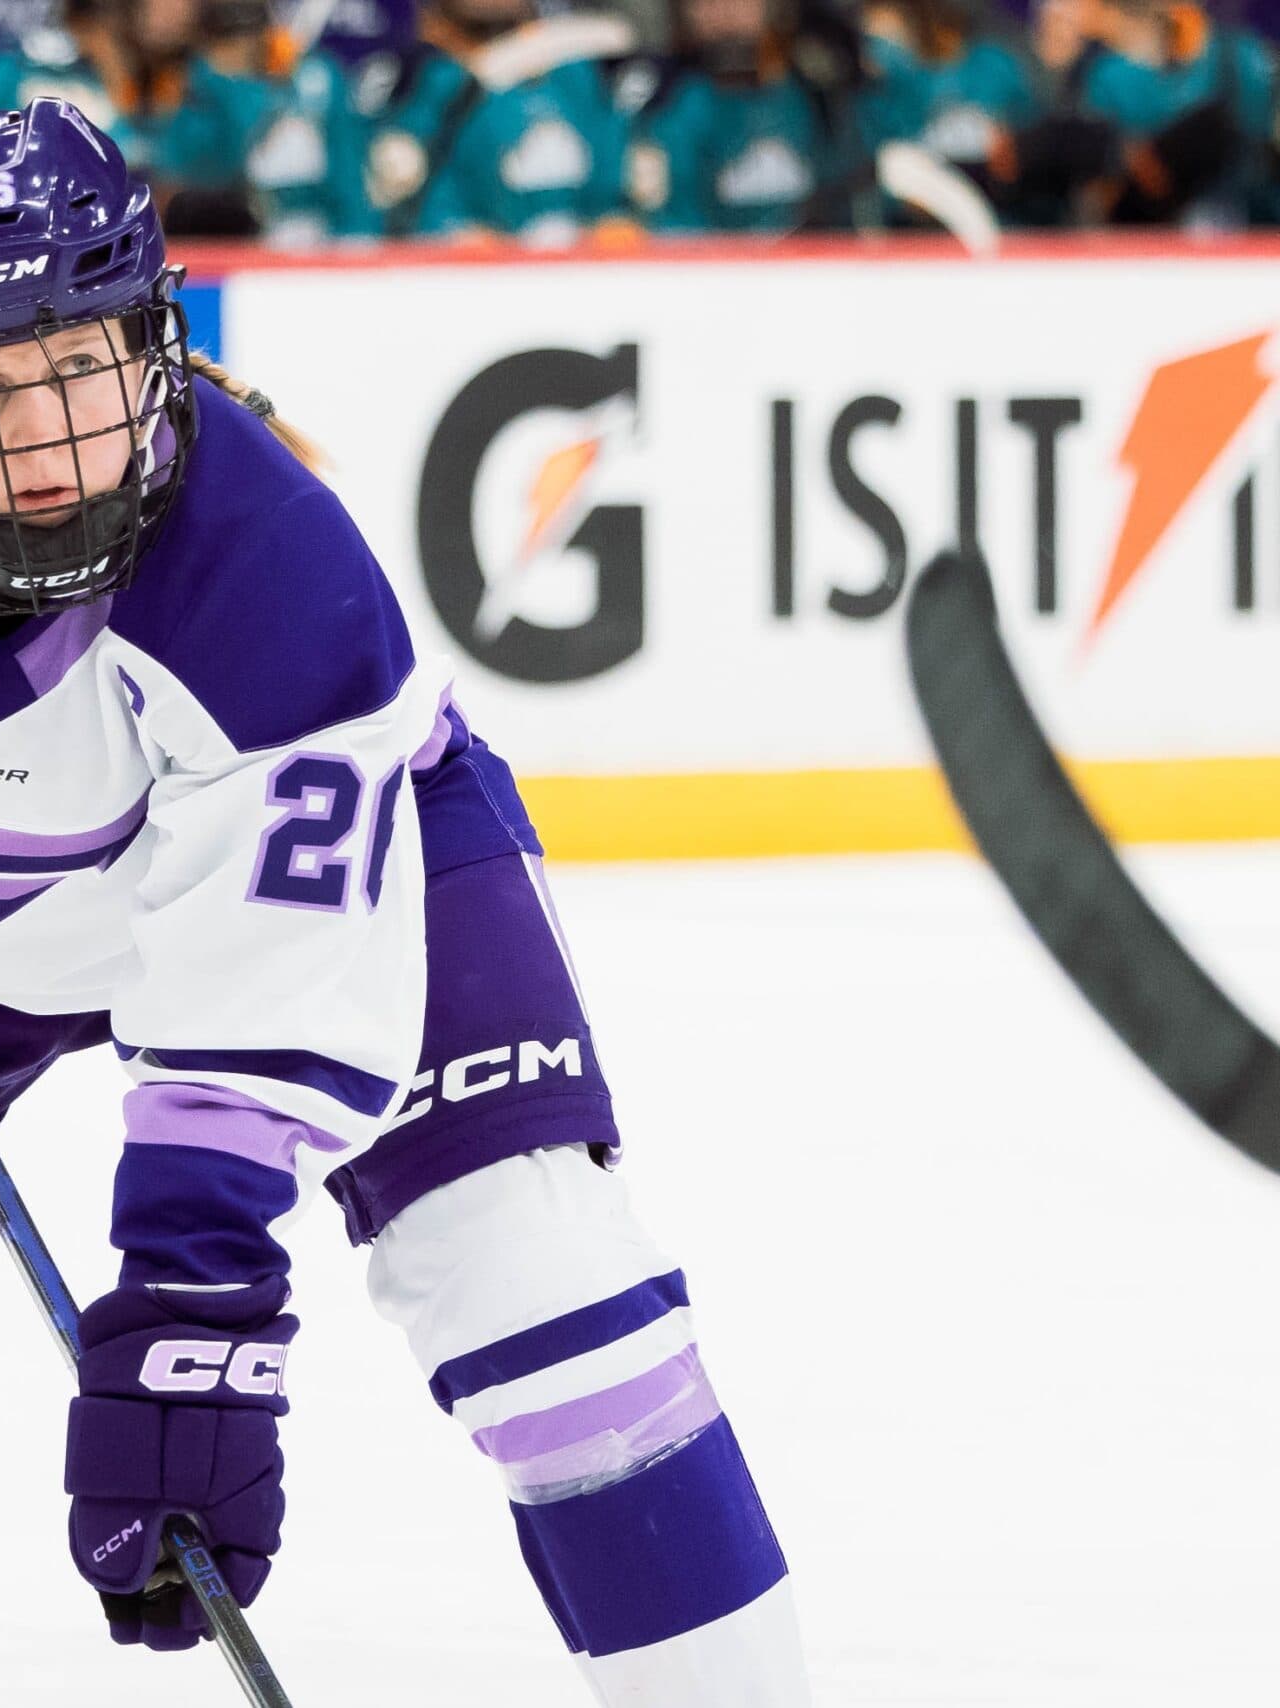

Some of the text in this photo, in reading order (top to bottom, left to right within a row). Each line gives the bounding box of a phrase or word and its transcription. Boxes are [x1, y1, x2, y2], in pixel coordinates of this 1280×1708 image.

[770, 394, 908, 619] IS
[956, 396, 1083, 615] IT
[9, 555, 110, 590] CCM
[138, 1339, 289, 1397] CC
[92, 1518, 143, 1564] CCM
[173, 1533, 228, 1601] OR
